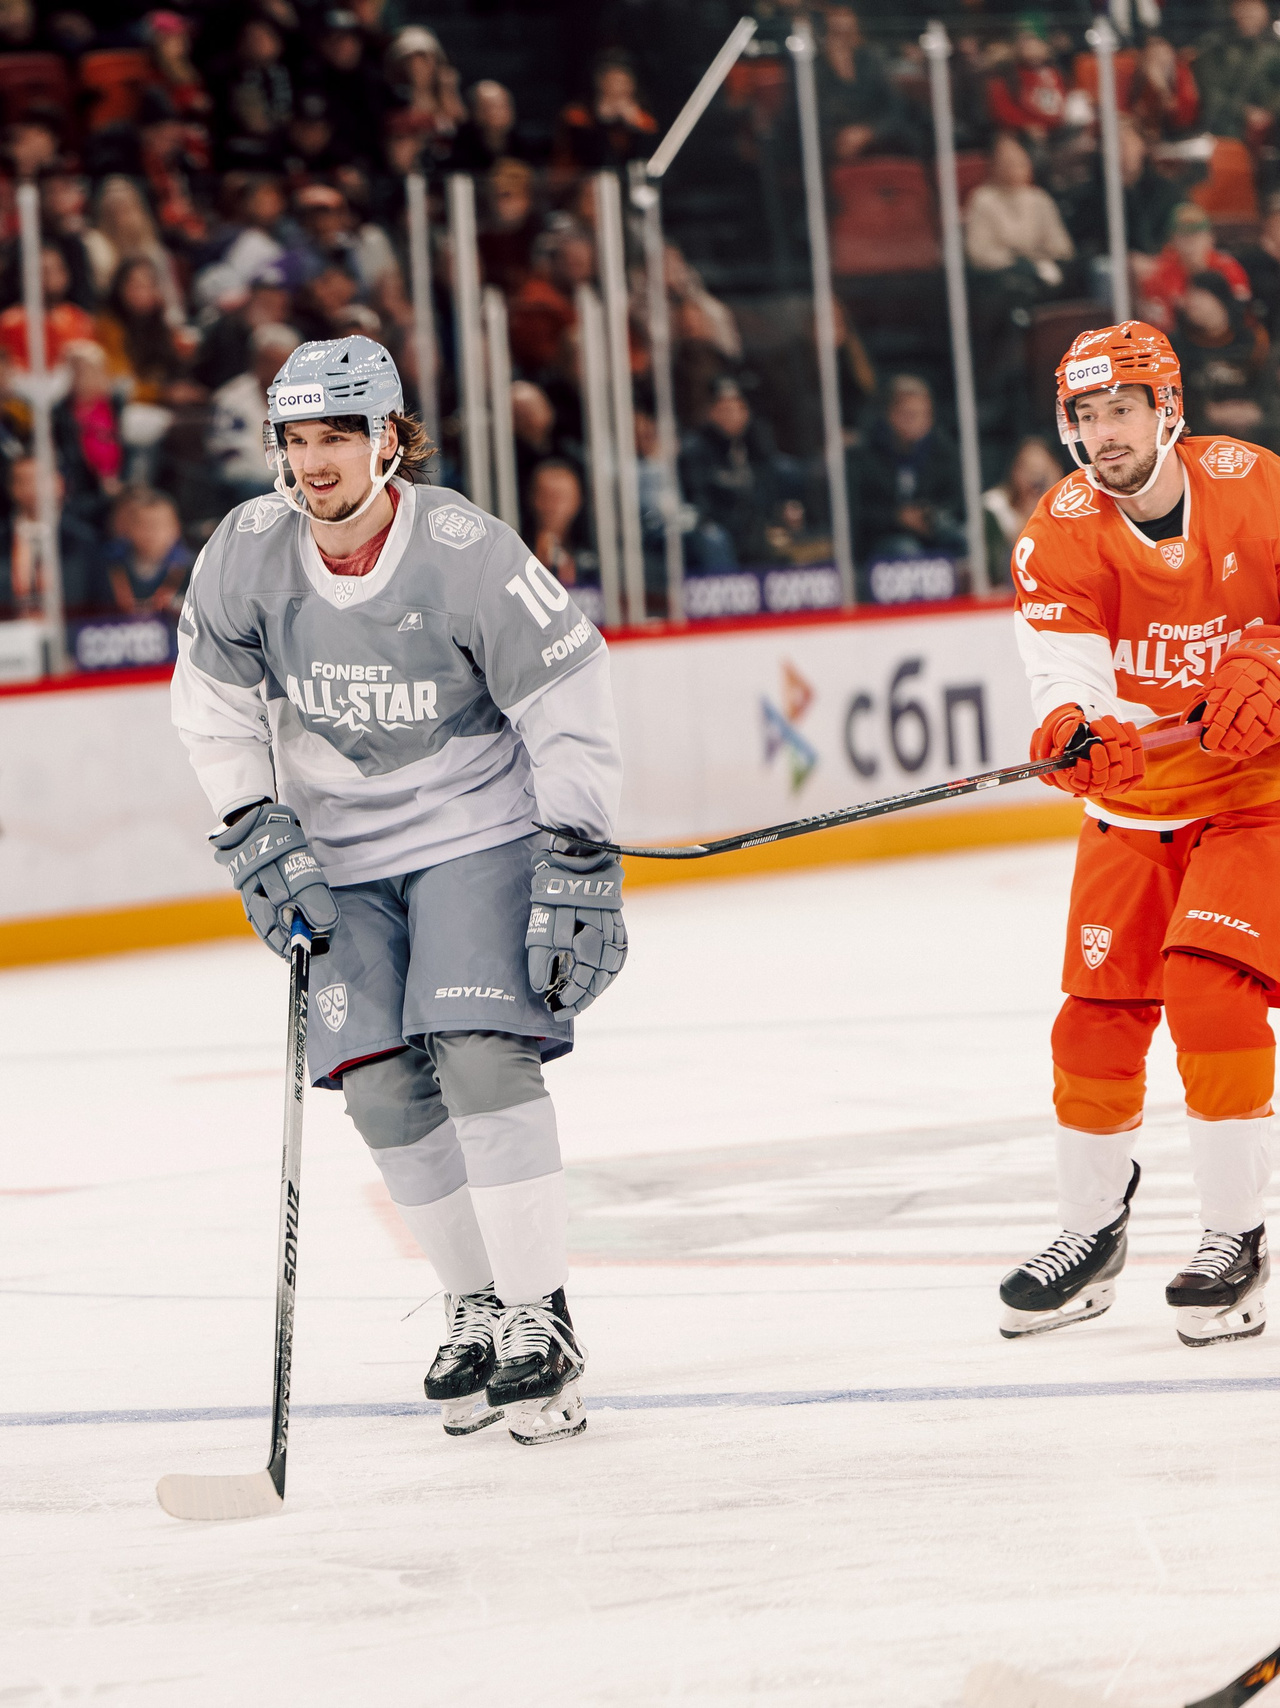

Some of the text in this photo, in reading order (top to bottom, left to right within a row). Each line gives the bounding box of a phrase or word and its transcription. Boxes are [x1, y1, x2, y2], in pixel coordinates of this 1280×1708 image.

[1068, 363, 1109, 381] согаз
[278, 393, 322, 406] согаз
[1217, 446, 1235, 473] URAL
[441, 512, 467, 538] RUS
[504, 555, 569, 630] 10
[1021, 602, 1068, 621] NBET
[1147, 614, 1228, 641] FONBET
[541, 613, 593, 668] FONBE
[310, 660, 393, 682] FONBET
[844, 657, 991, 778] сбп
[535, 878, 615, 898] SOYUZ
[1185, 908, 1252, 933] SOYUZ
[434, 986, 504, 999] SOYUZ
[283, 1179, 300, 1291] SOYUZ
